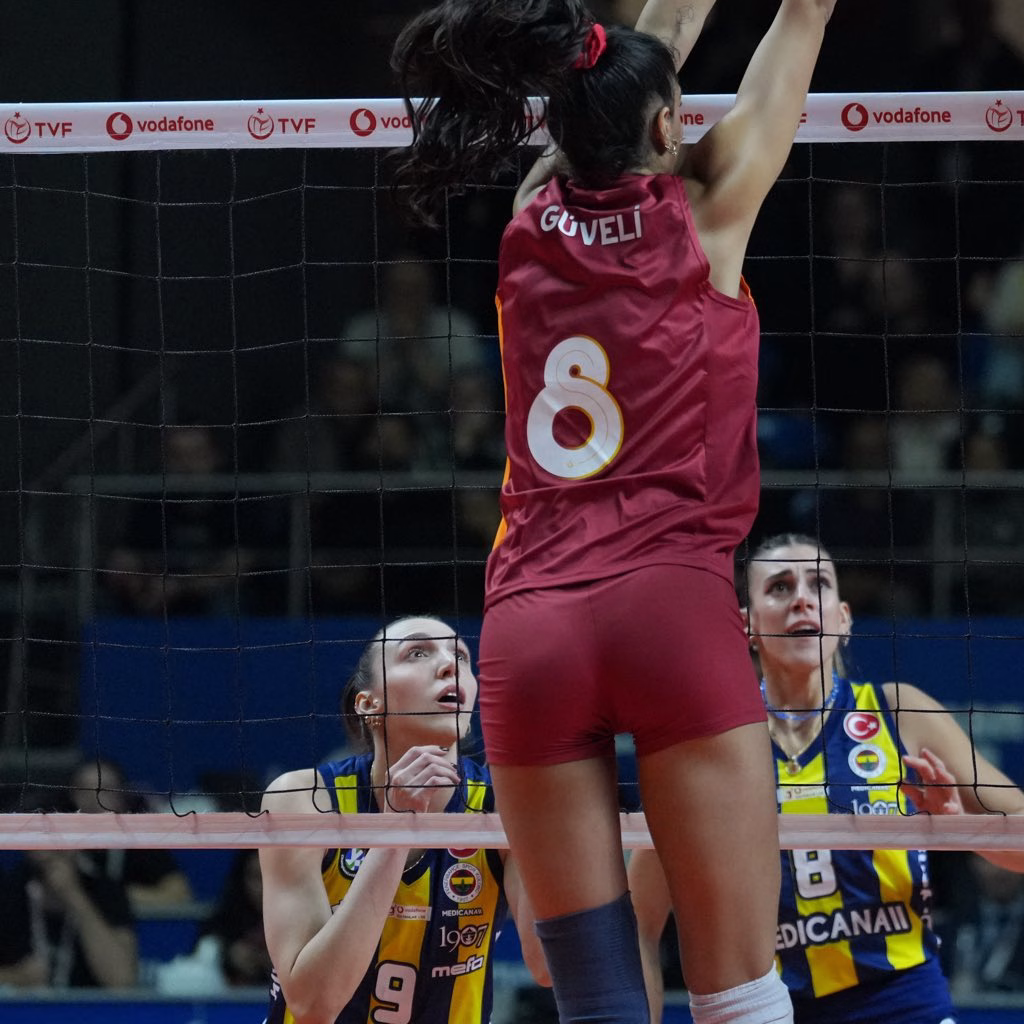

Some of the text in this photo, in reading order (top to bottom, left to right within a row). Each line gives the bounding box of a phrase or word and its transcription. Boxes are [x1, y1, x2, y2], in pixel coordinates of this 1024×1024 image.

[872, 106, 952, 123] vodafone
[35, 121, 73, 138] TVF
[138, 115, 215, 132] vodafone
[278, 118, 317, 134] TVF
[526, 334, 625, 480] 8
[791, 849, 838, 900] 8
[372, 962, 418, 1024] 9
